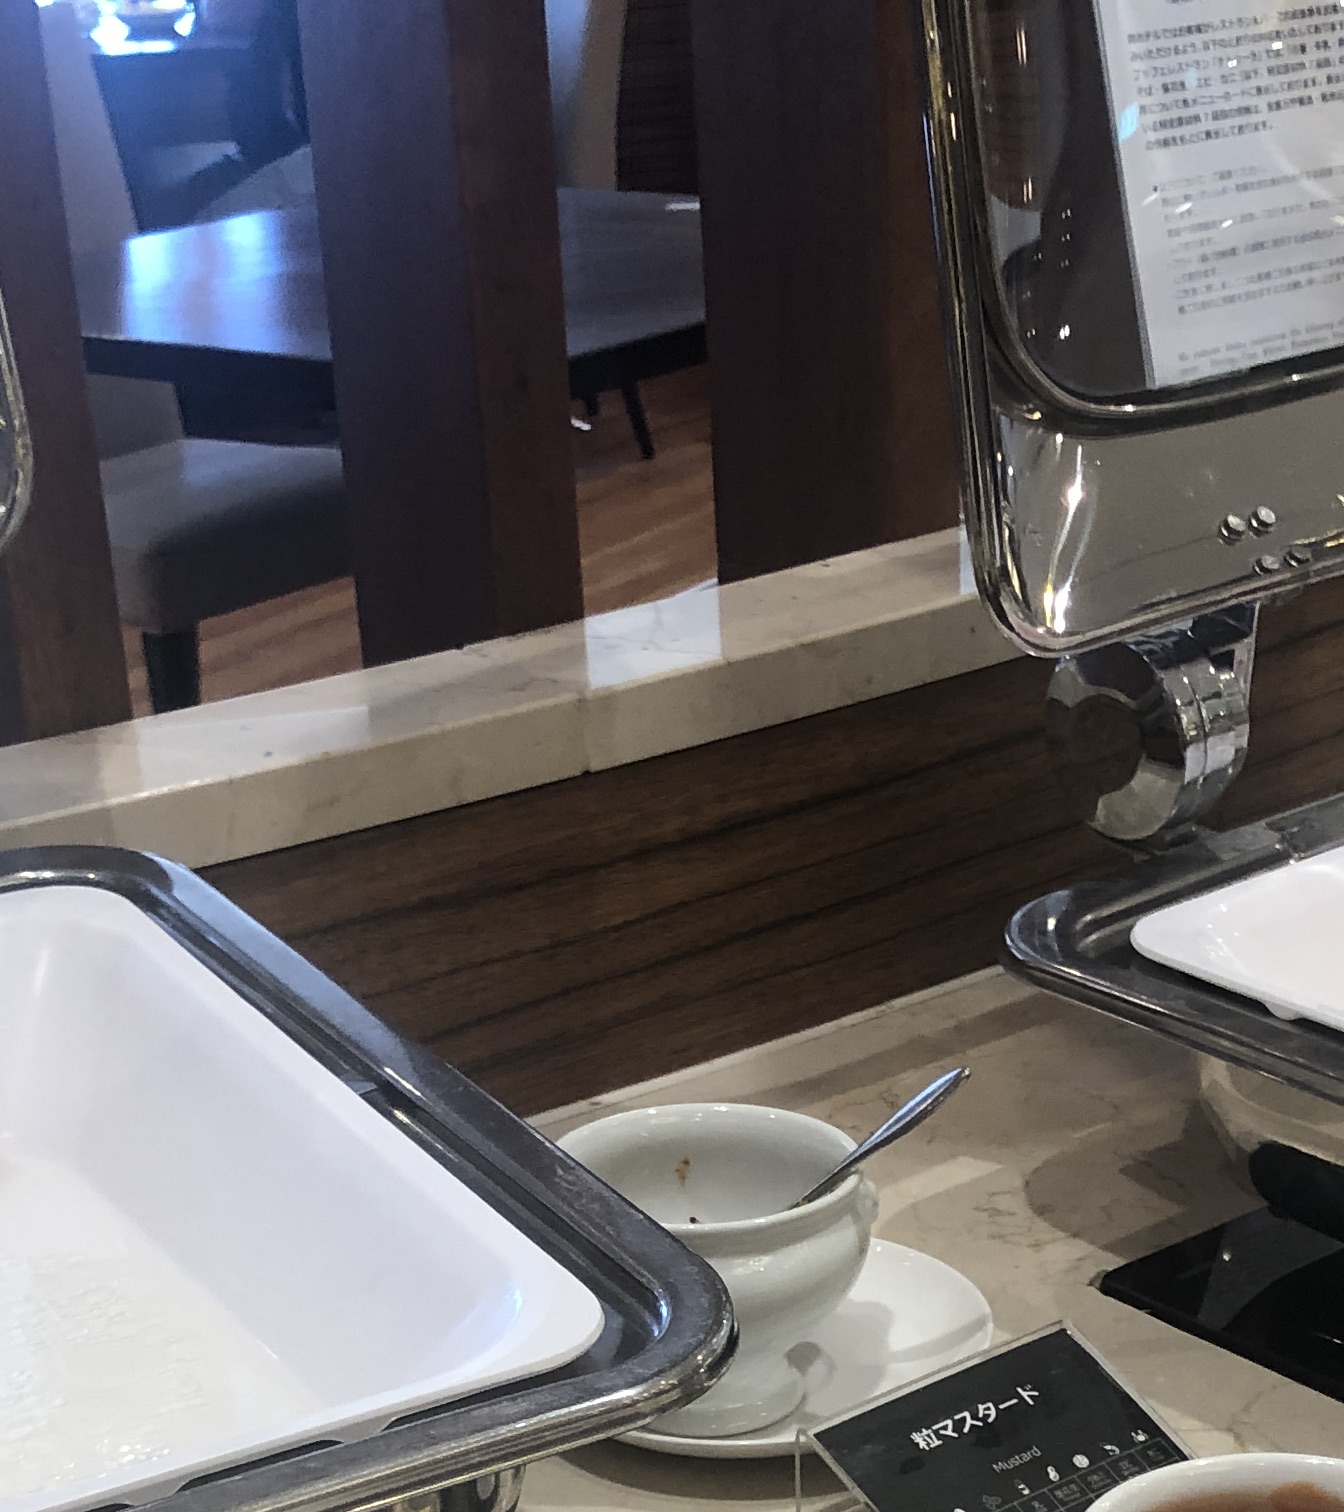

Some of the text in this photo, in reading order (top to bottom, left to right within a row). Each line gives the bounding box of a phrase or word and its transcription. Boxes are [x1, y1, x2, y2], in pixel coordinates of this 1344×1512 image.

[910, 1383, 1040, 1451] 粒マスタード
[992, 1445, 1042, 1474] Mustard
